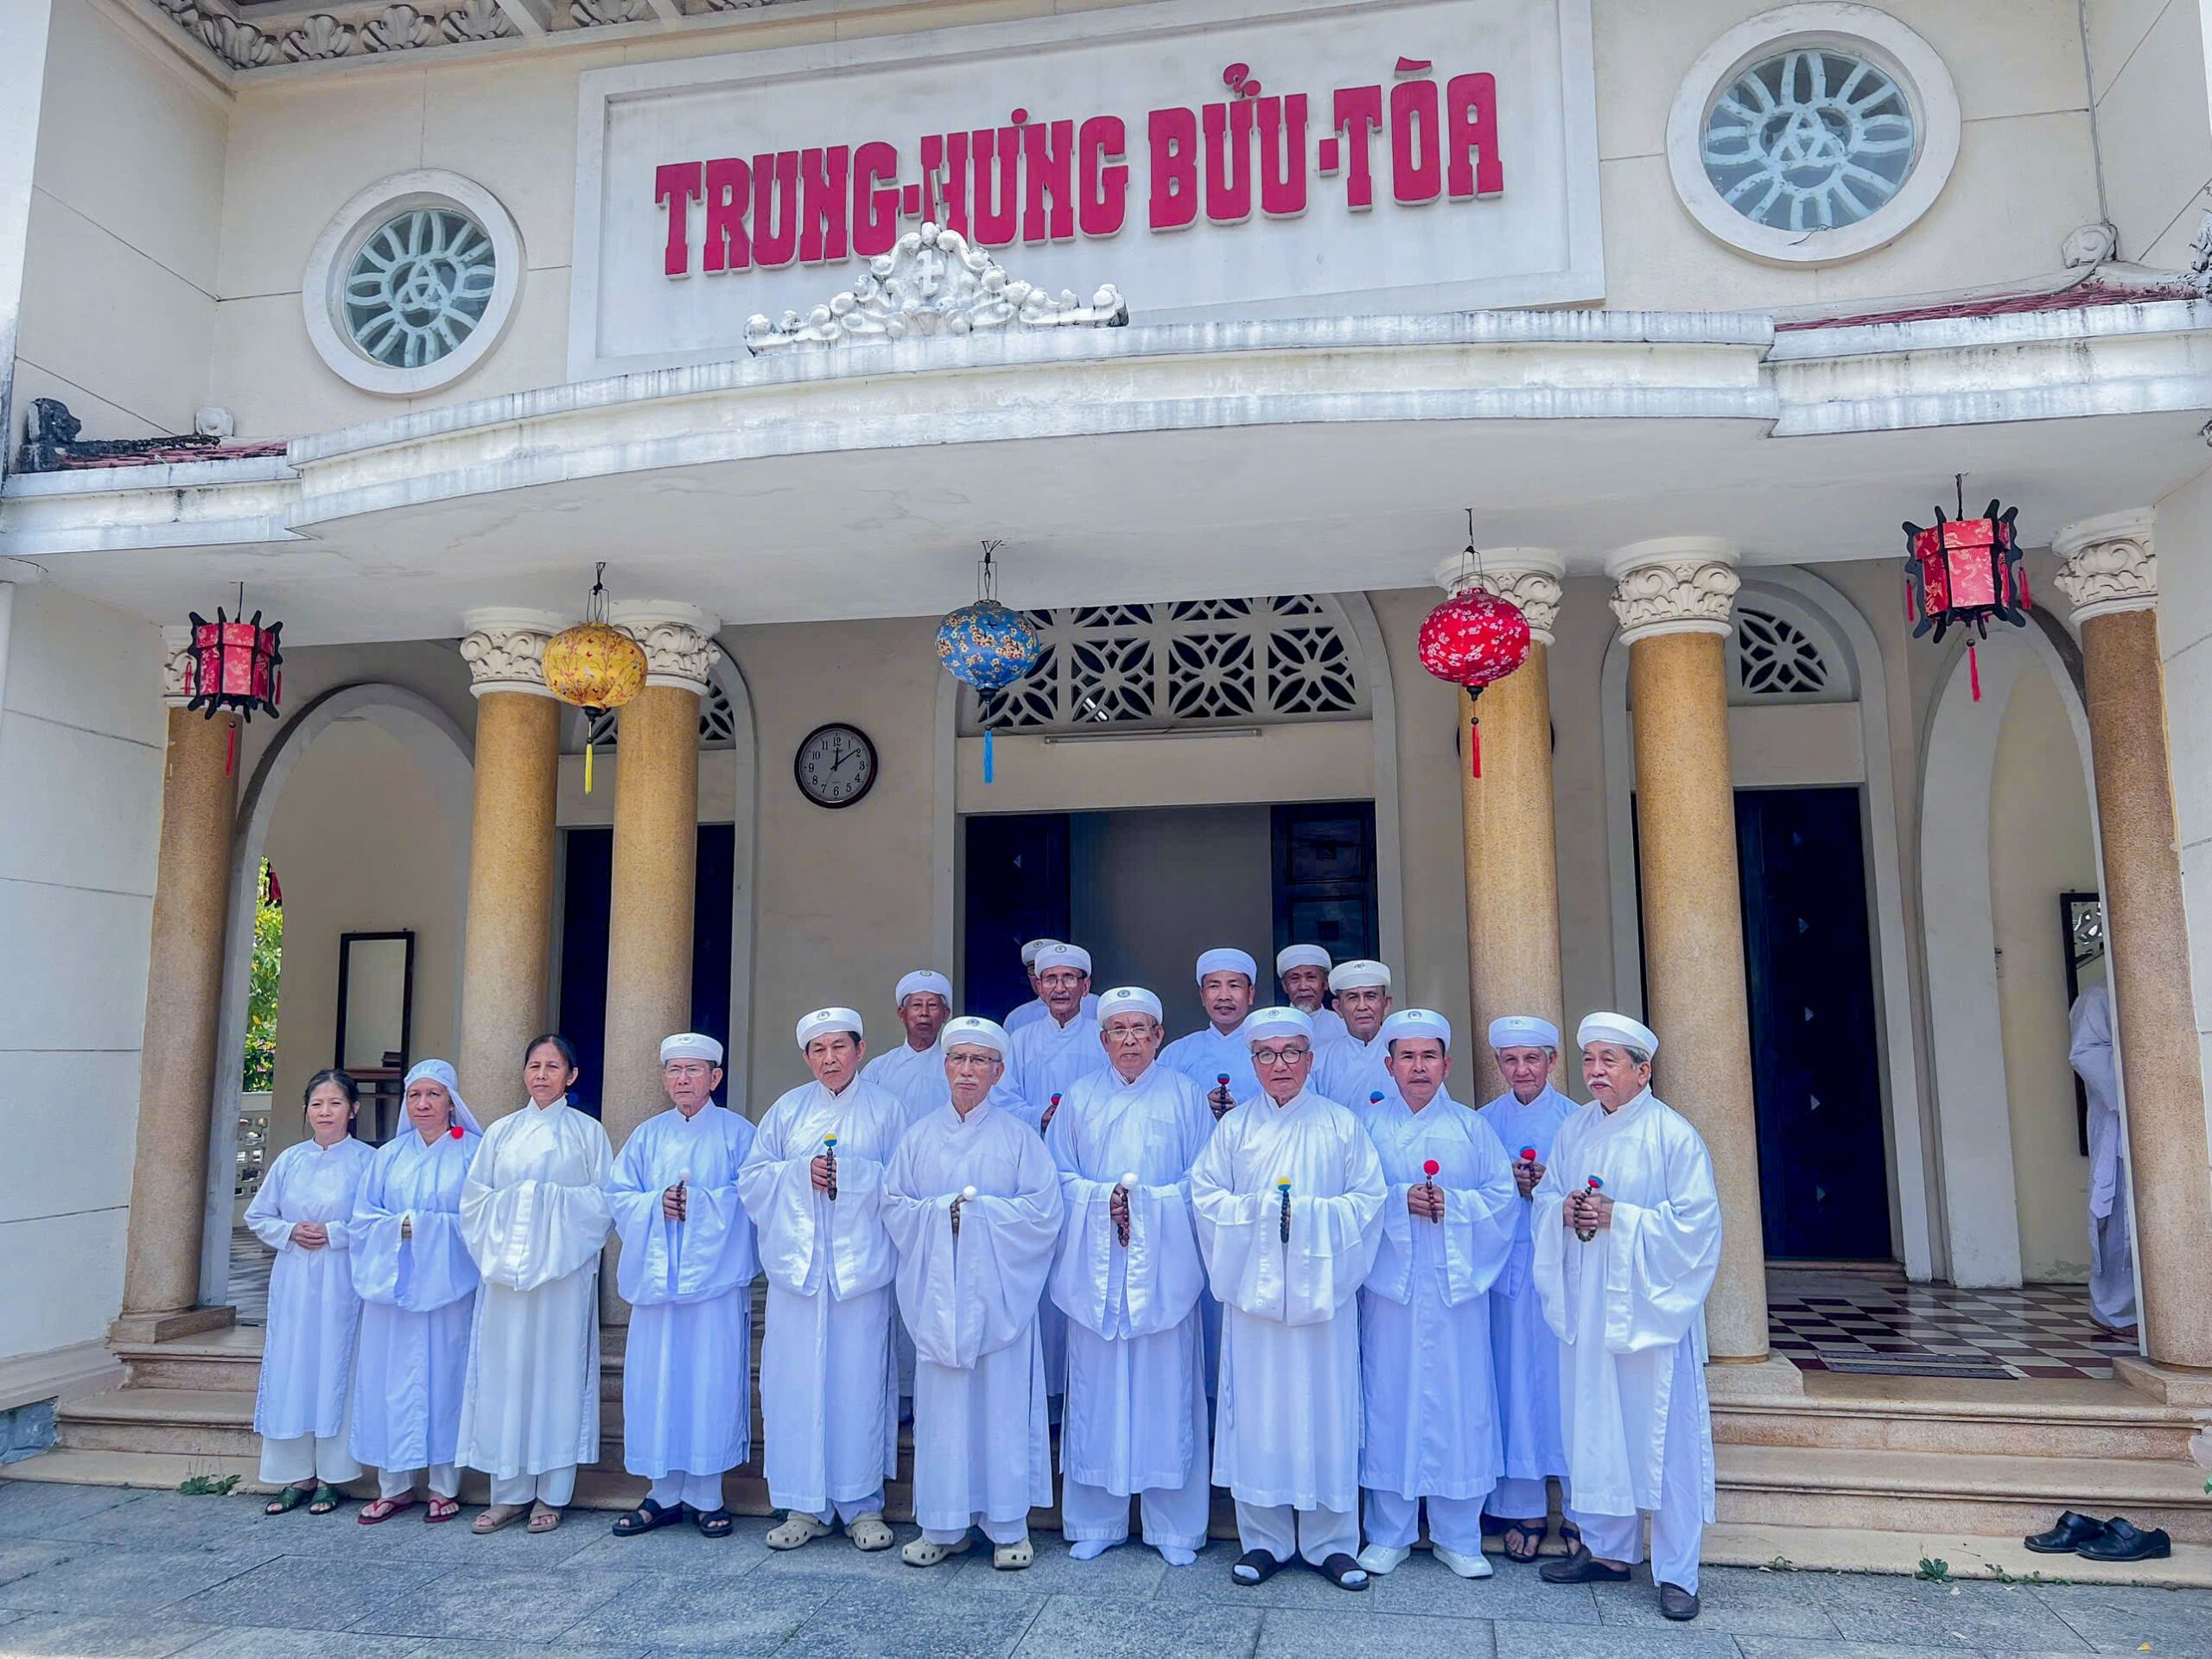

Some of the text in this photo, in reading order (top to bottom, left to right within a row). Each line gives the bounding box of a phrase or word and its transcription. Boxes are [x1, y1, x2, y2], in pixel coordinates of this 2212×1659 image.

[1148, 56, 1504, 232] BỬU-TÒA
[833, 737, 841, 747] 12
[812, 751, 821, 760] 10
[808, 762, 815, 772] 9
[812, 774, 818, 785] 8
[855, 772, 861, 783] 4
[833, 785, 840, 796] 6
